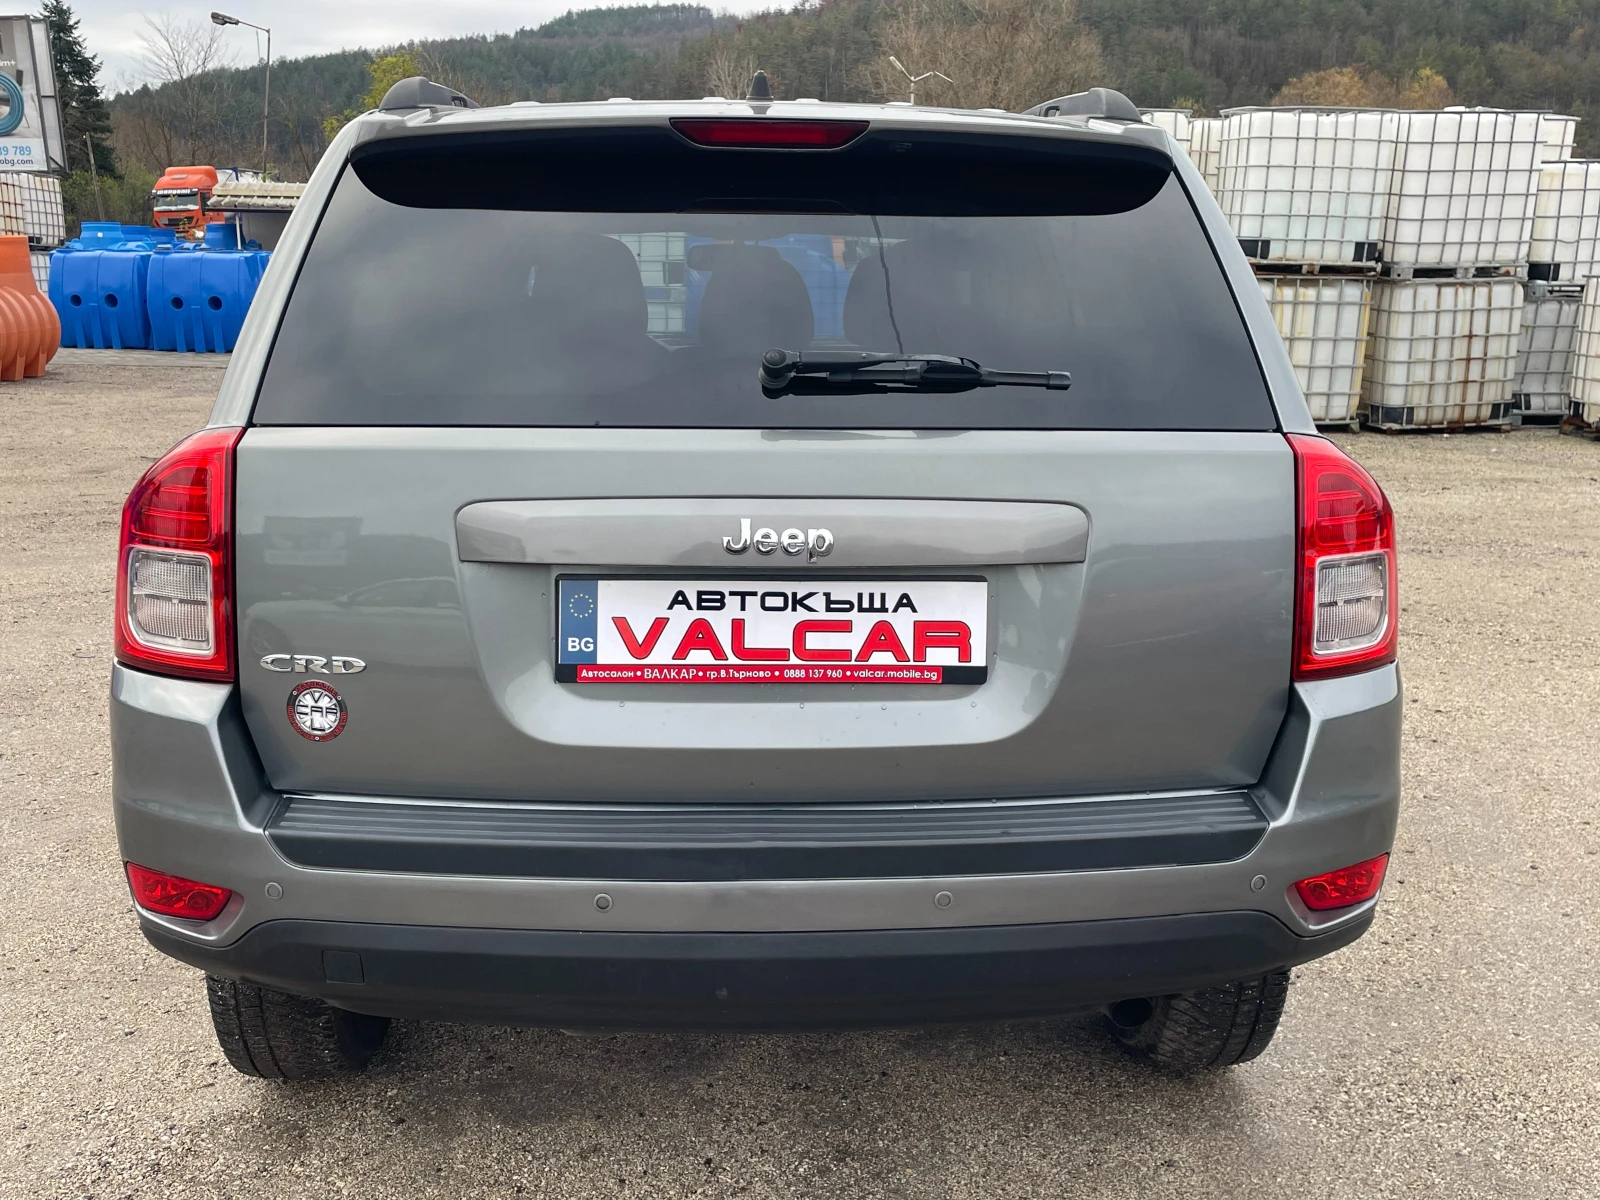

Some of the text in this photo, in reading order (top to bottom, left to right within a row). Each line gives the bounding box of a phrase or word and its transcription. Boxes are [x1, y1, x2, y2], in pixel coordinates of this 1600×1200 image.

[12, 145, 32, 156] 789
[722, 518, 834, 563] Jeep
[666, 590, 918, 613] АВТОКЪЩА
[567, 637, 594, 652] BG
[611, 616, 972, 663] VALCAR
[260, 653, 367, 674] CRD
[581, 669, 635, 678] Автосалон
[644, 668, 697, 679] ВАЛКАР
[783, 669, 806, 678] 0888
[808, 669, 825, 678] 137
[826, 669, 843, 678] 960
[853, 668, 938, 681] valcar.mobile.bg
